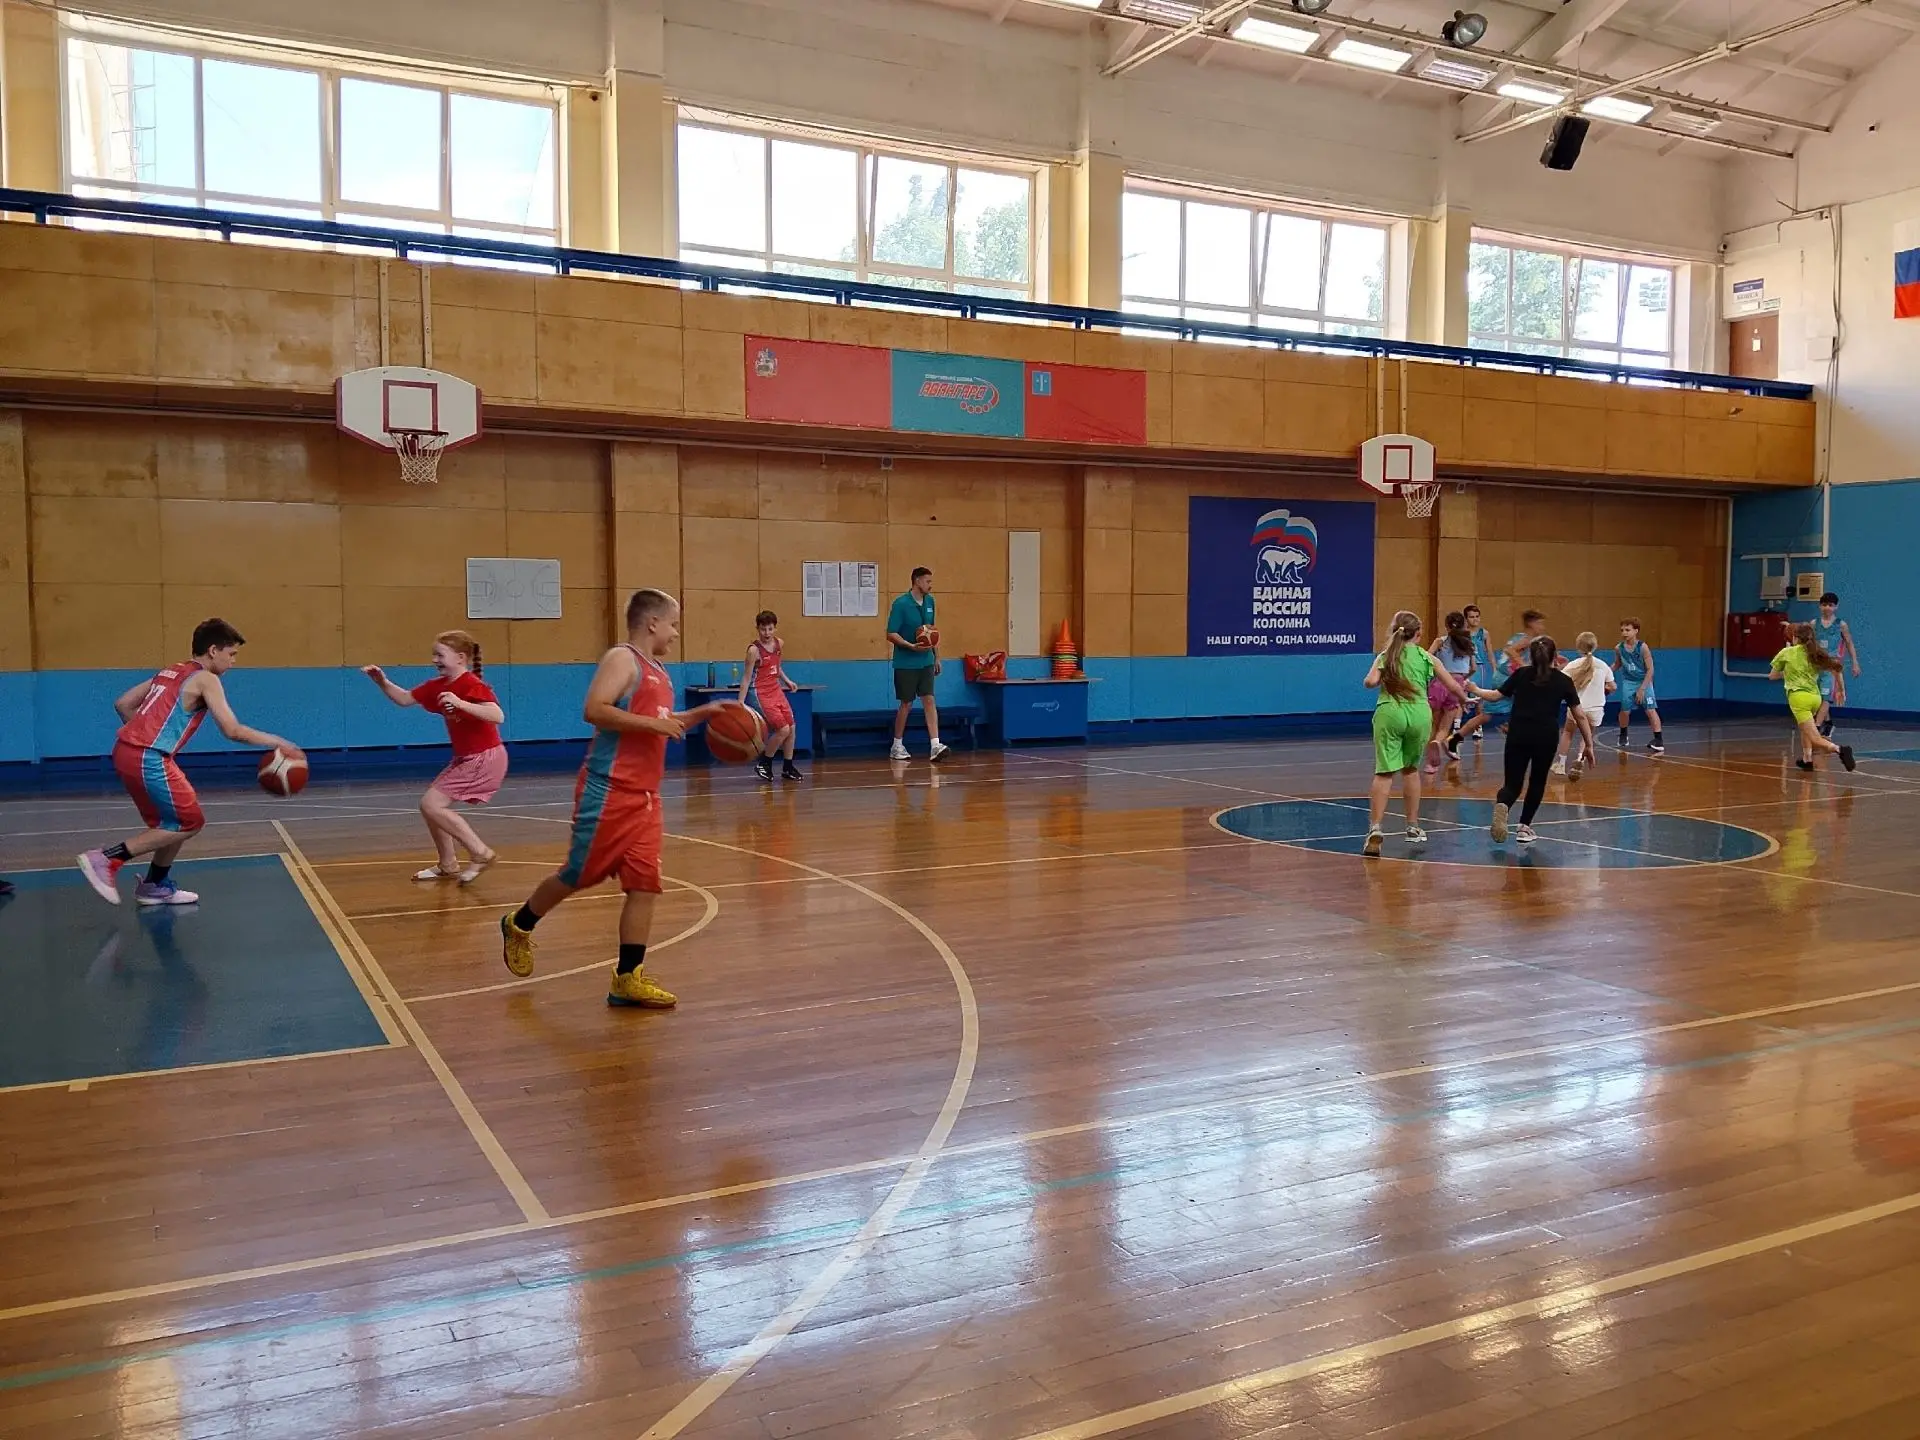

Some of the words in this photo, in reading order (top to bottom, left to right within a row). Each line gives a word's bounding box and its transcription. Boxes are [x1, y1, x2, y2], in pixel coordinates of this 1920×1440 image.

[1253, 587, 1311, 601] ЕДИНАЯ
[1253, 601, 1311, 615] РОССИЯ
[1253, 618, 1310, 629] КОЛОМНА
[1207, 635, 1231, 645] НАШ
[1234, 635, 1267, 646] ГОРОД
[1276, 635, 1303, 645] ОДНА
[1306, 634, 1356, 644] КОМАНДА!
